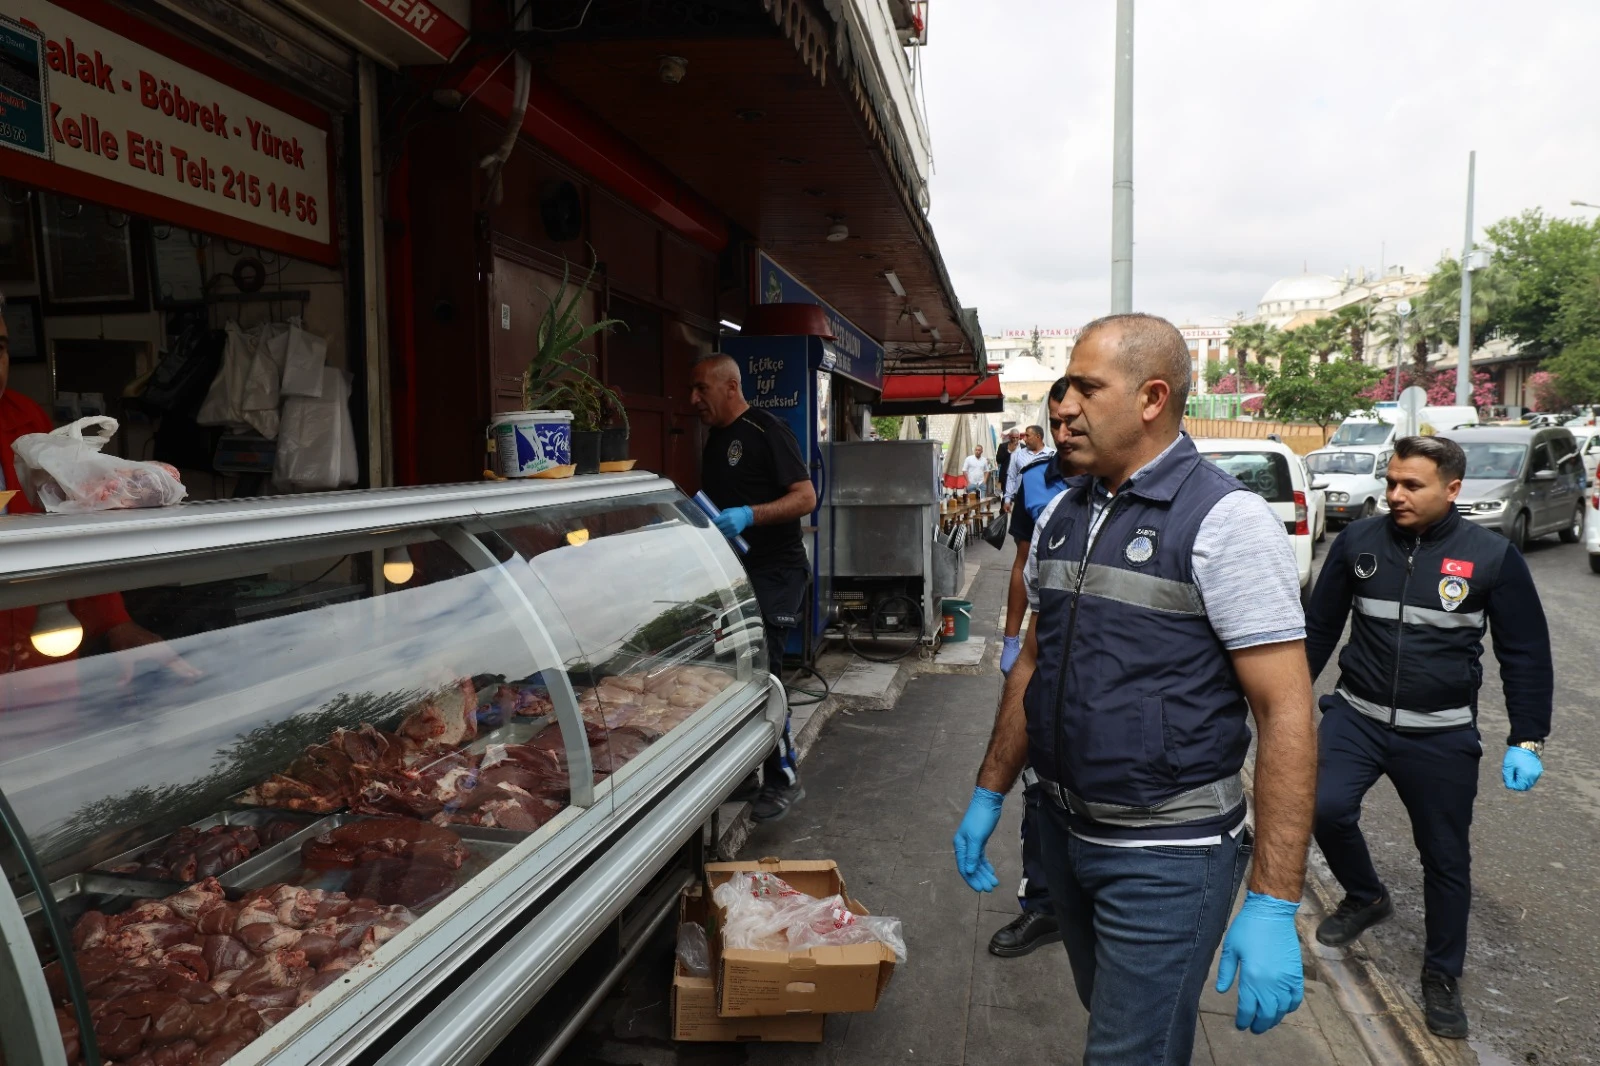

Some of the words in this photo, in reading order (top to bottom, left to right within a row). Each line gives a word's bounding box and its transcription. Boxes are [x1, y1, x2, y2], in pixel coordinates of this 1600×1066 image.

[36, 27, 115, 94] alak
[139, 70, 229, 139] Böbrek
[245, 116, 305, 169] Yürek
[126, 129, 164, 176] Eti
[169, 145, 216, 193] Tel:
[221, 164, 261, 207] 215
[267, 182, 291, 217] 14
[295, 191, 318, 226] 56
[1029, 328, 1061, 337] TPTAN
[747, 390, 799, 409] edeceksin!
